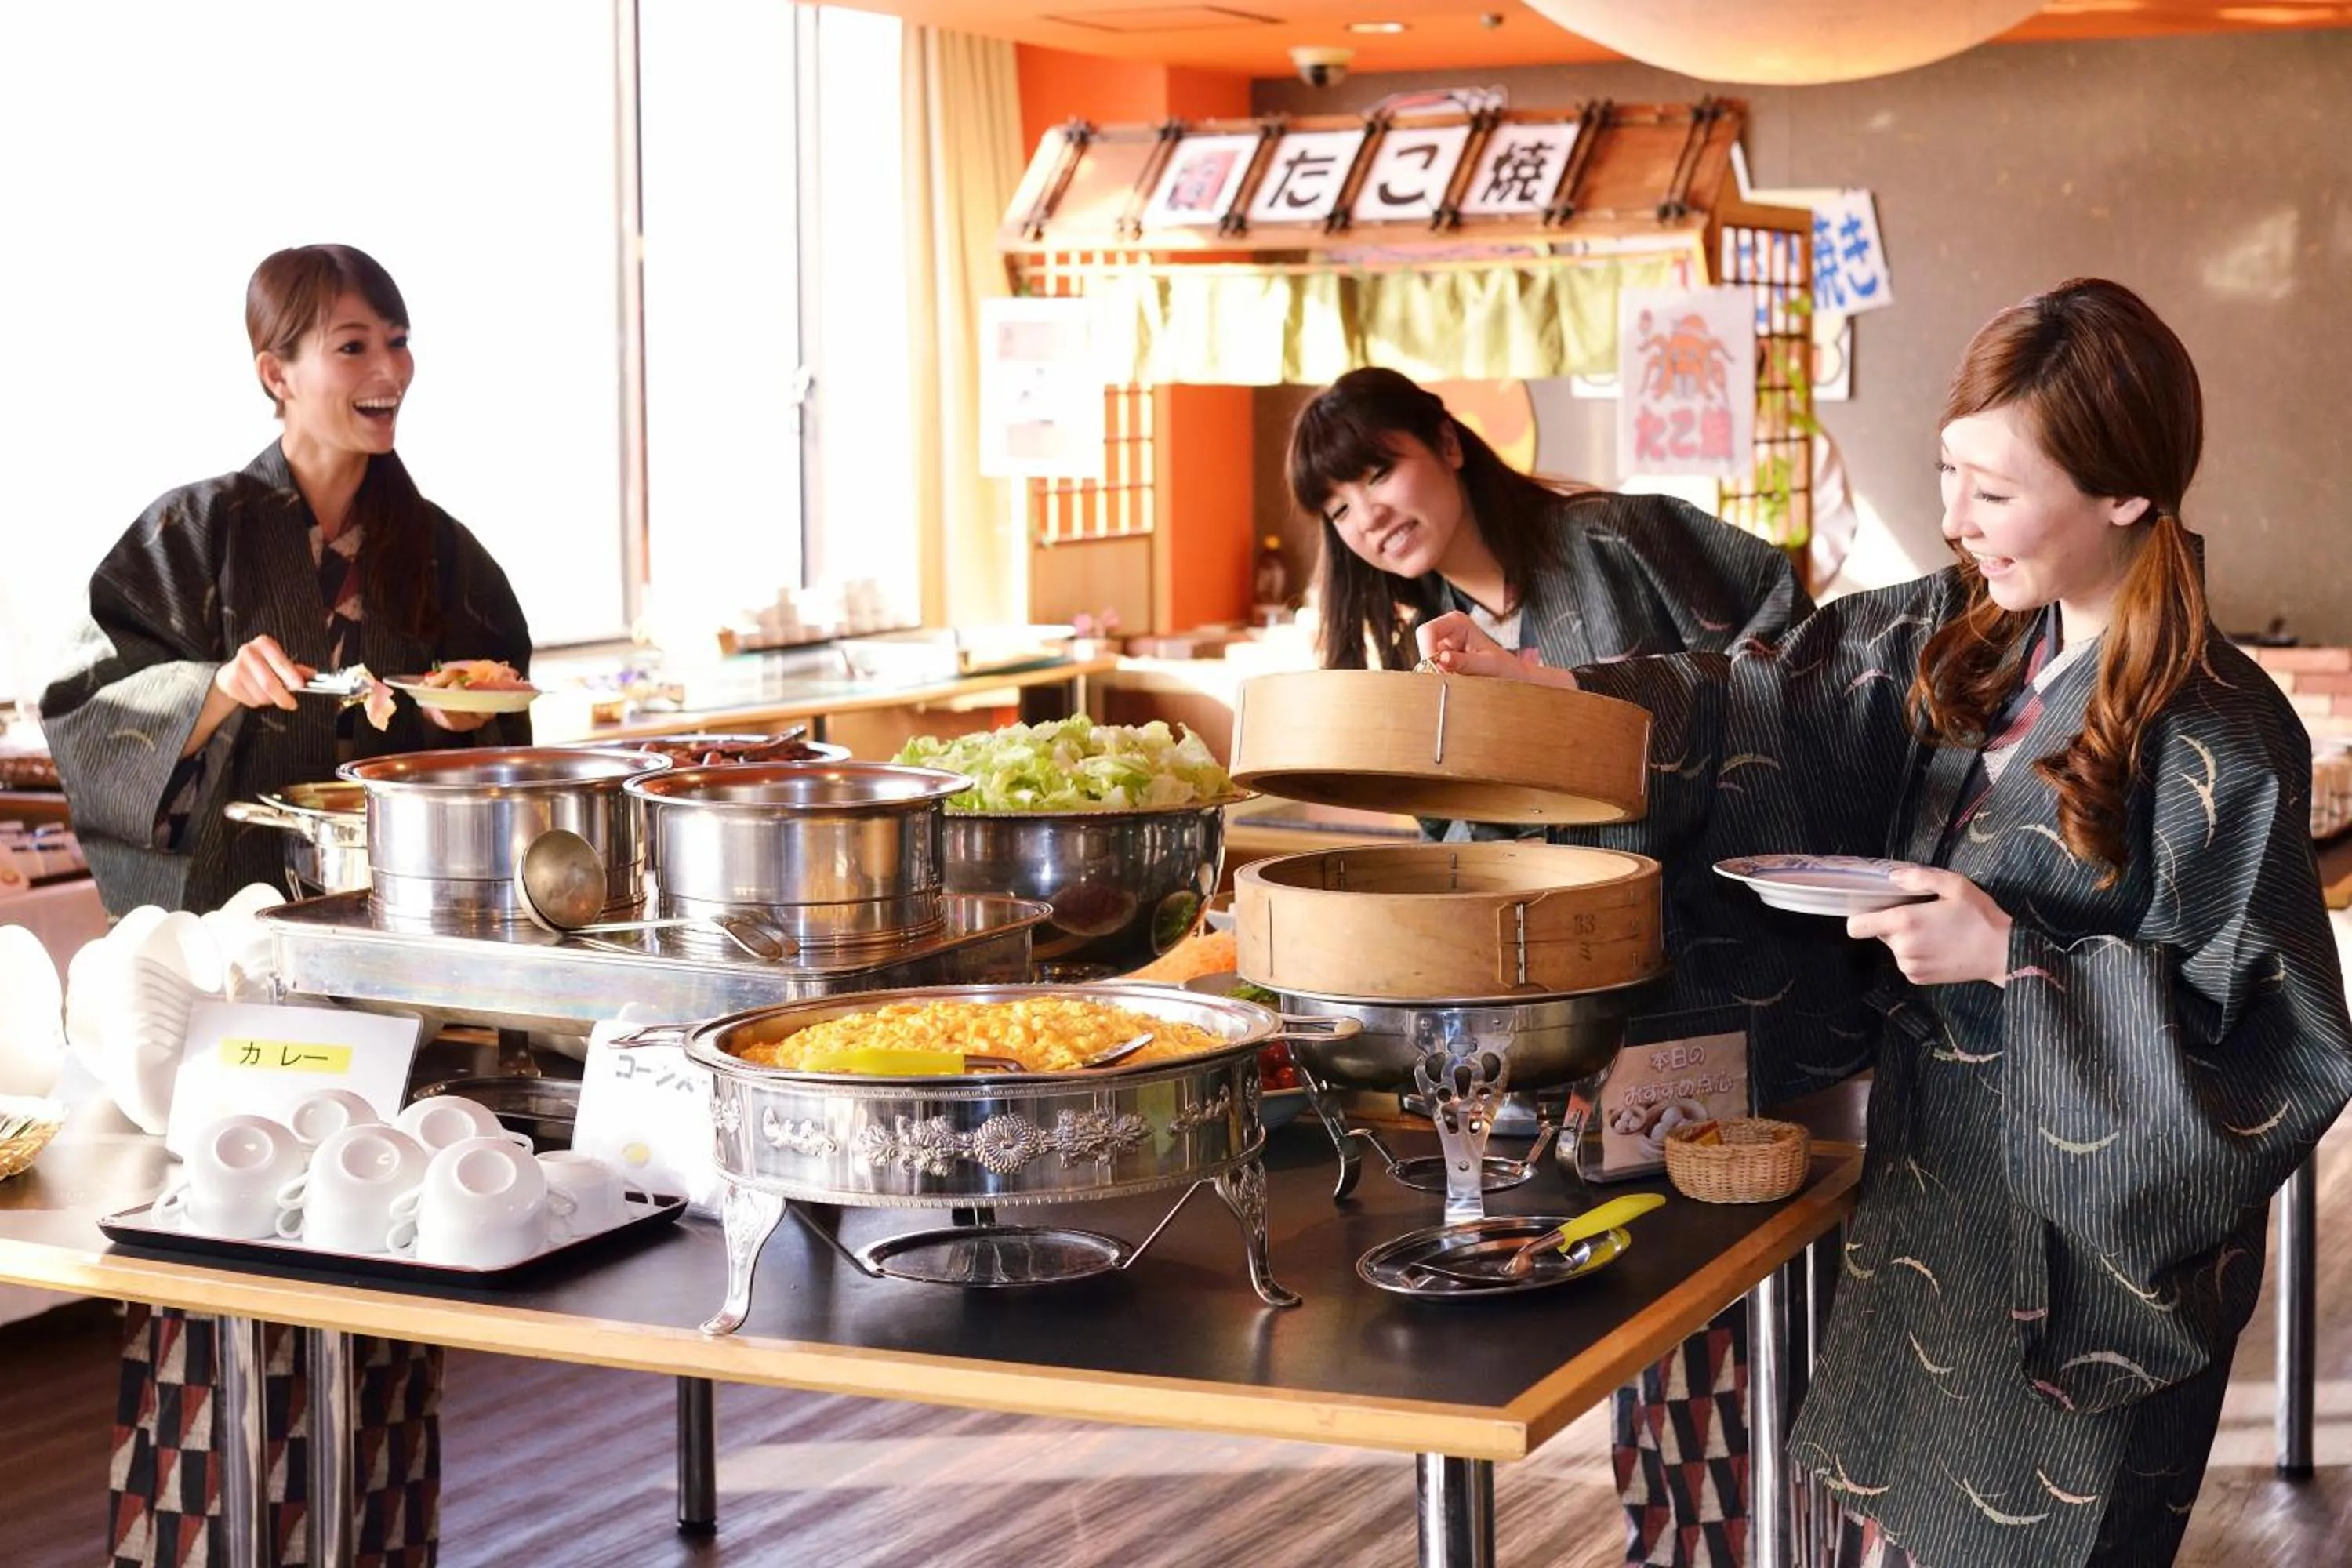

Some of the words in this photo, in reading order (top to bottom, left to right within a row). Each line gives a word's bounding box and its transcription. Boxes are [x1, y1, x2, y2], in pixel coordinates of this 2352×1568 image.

[1269, 141, 1555, 209] たこ焼
[240, 1041, 328, 1066] カレー
[1650, 1044, 1707, 1073] 本日の
[1624, 1069, 1735, 1106] おすすめ点心
